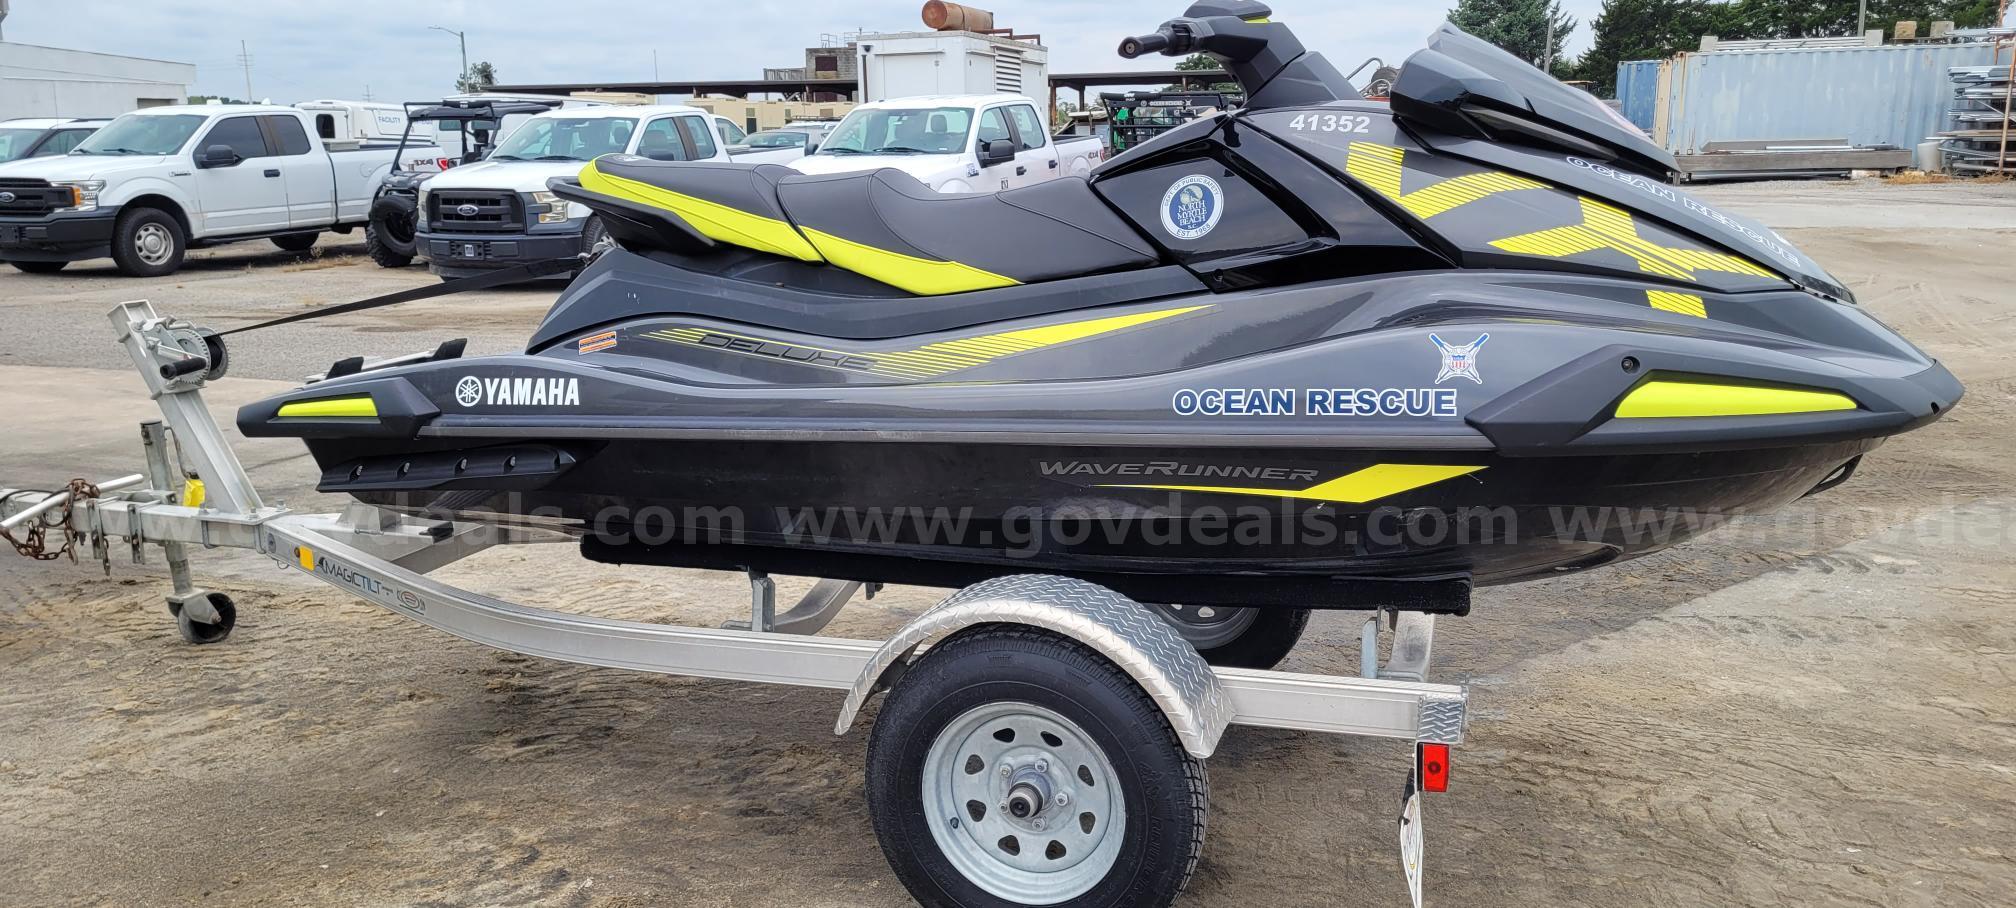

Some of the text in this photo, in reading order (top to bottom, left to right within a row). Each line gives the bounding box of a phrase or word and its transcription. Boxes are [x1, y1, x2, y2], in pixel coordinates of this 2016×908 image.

[1289, 114, 1370, 133] 41352
[1203, 179, 1220, 195] SAFETY
[1177, 208, 1207, 220] MYRTLE
[1178, 200, 1206, 213] NORTH
[1566, 156, 1801, 267] OCEAN RESCUE
[1180, 214, 1206, 226] BEACH
[698, 333, 874, 371] DELUXE
[484, 378, 580, 406] YAMAHA
[1173, 388, 1457, 416] OCEAN RESCUE
[324, 560, 382, 595] MAGICTILT
